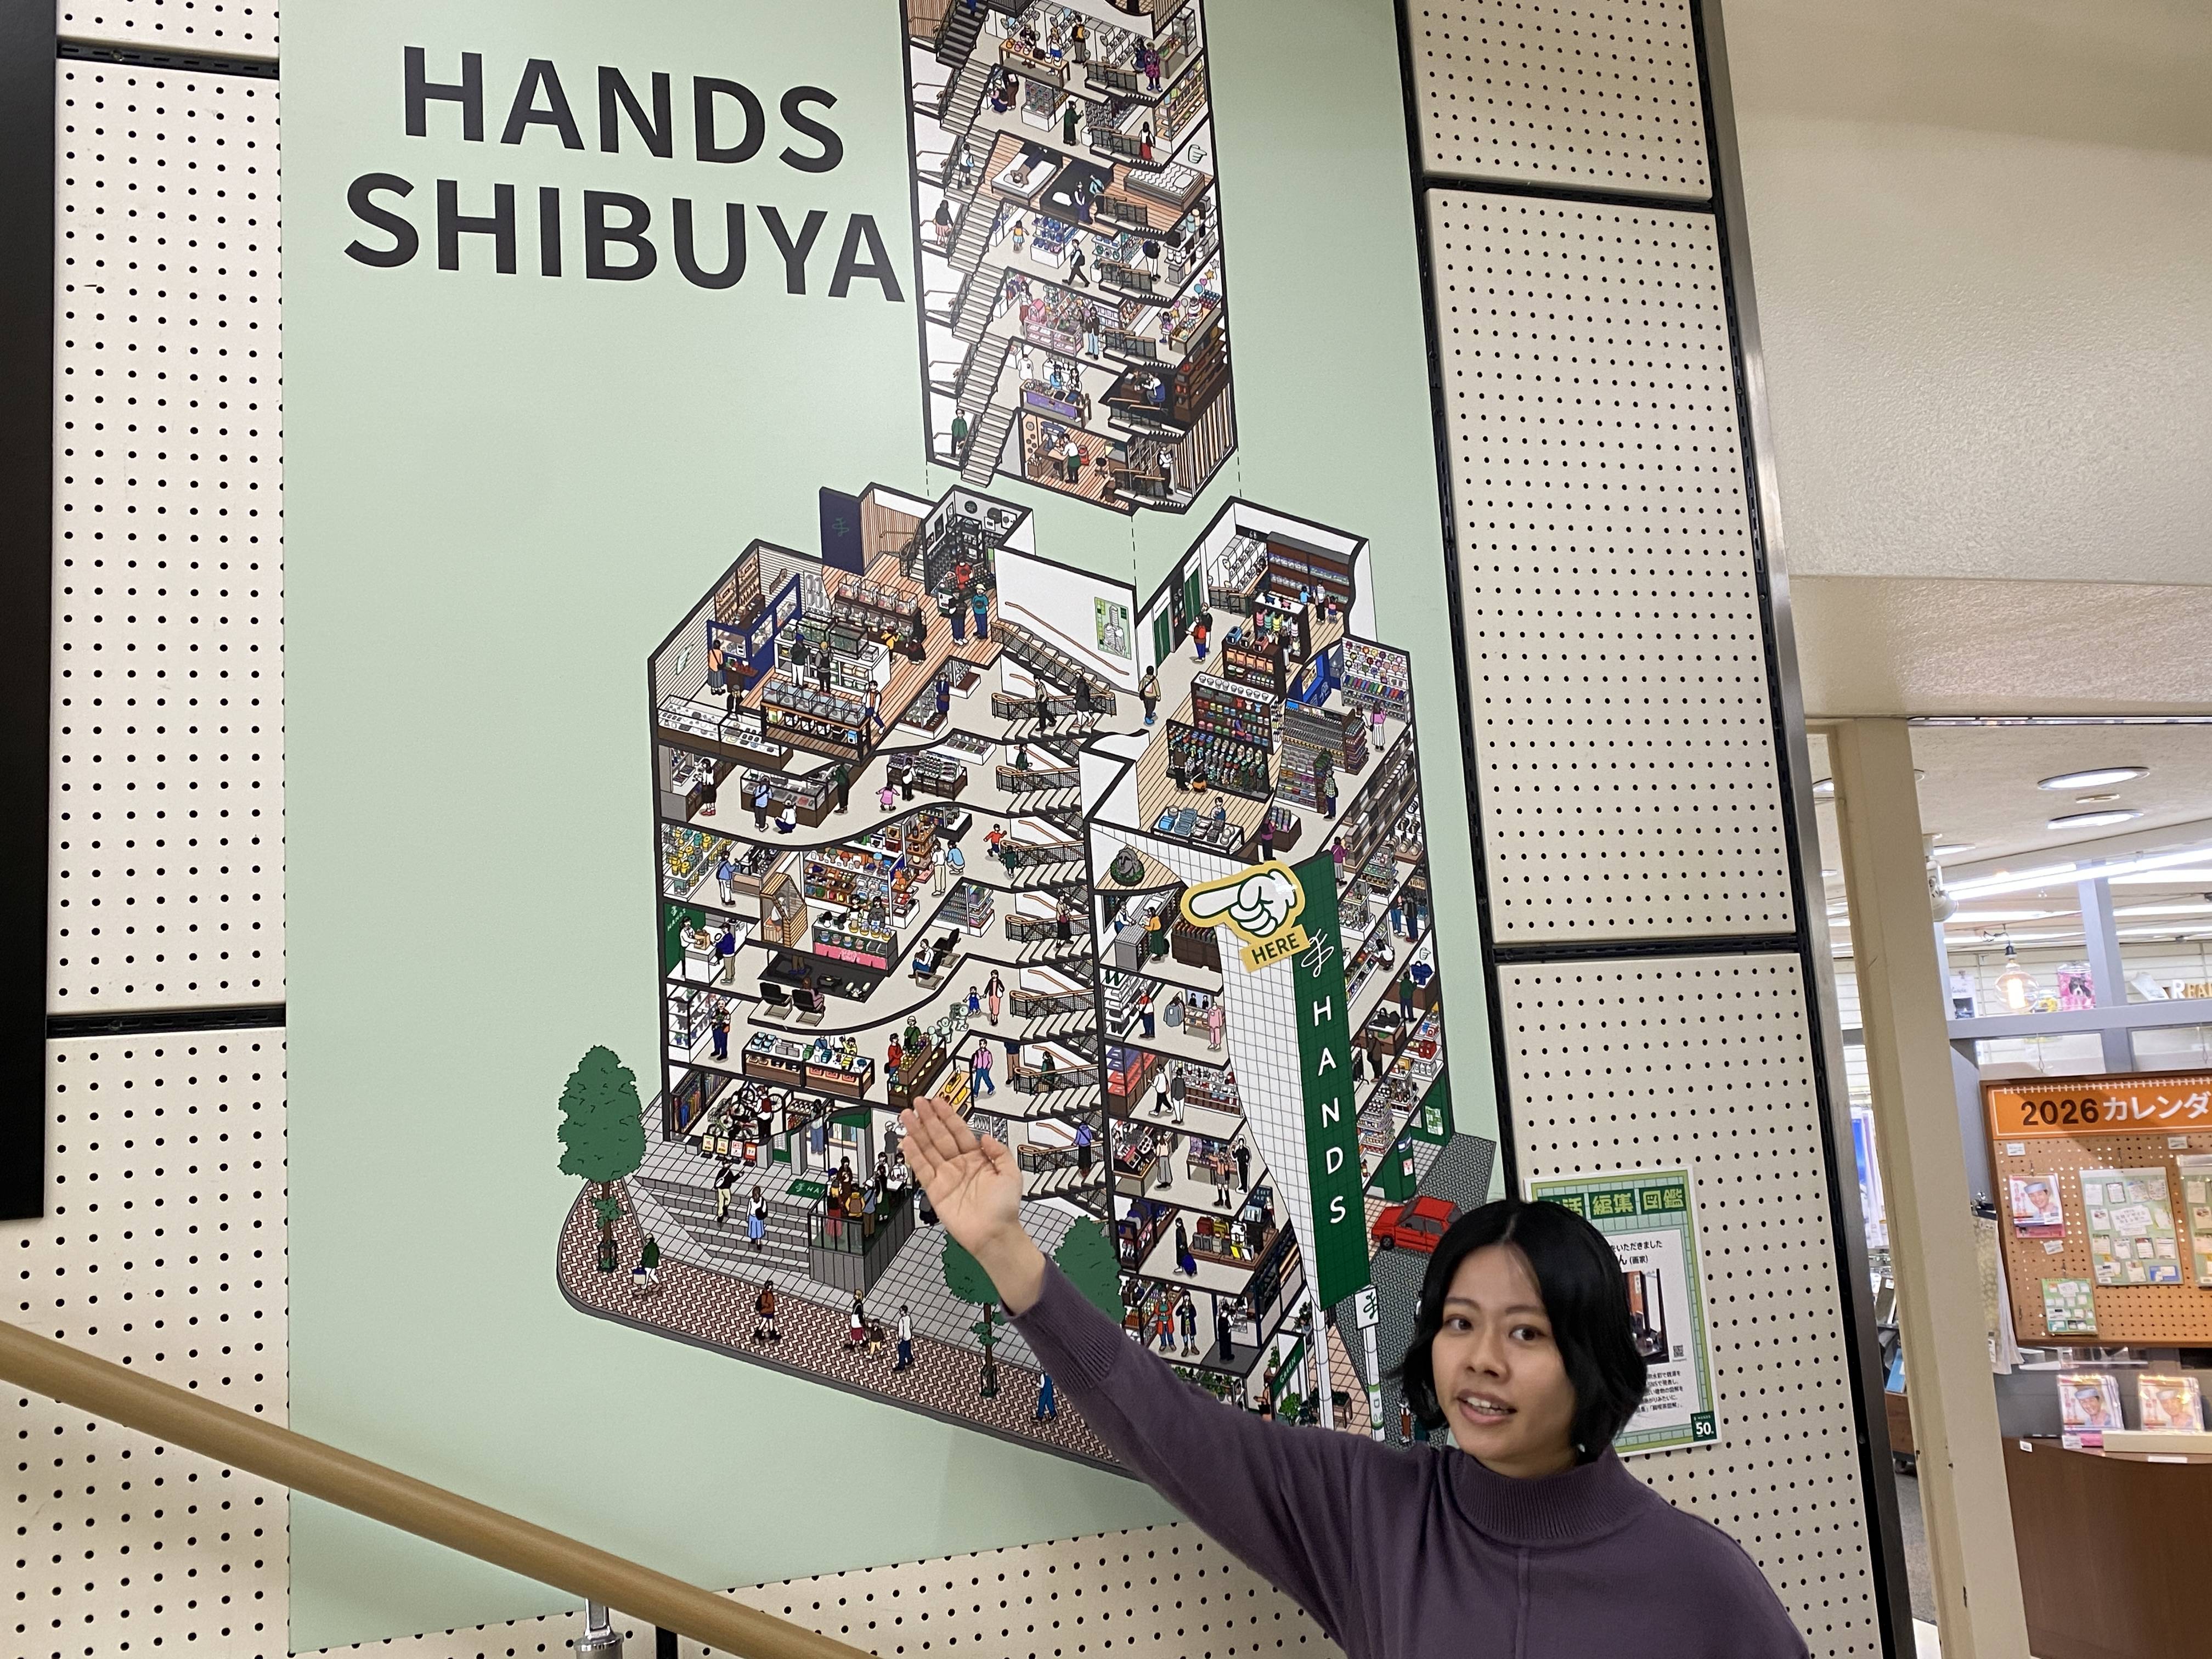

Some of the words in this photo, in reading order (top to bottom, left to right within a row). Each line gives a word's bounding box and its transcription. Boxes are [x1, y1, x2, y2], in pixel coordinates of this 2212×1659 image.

[404, 46, 844, 173] HANDS
[343, 172, 906, 303] SHIBUYA
[667, 908, 686, 932] HANDS
[1251, 932, 1300, 964] HERE
[1313, 996, 1346, 1223] HANDS
[2021, 1098, 2100, 1126] 2026
[2103, 1091, 2211, 1121] カレンダ
[1592, 1193, 1634, 1216] 編集
[1643, 1188, 1684, 1210] 図鑑
[1279, 1356, 1296, 1383] GREEN
